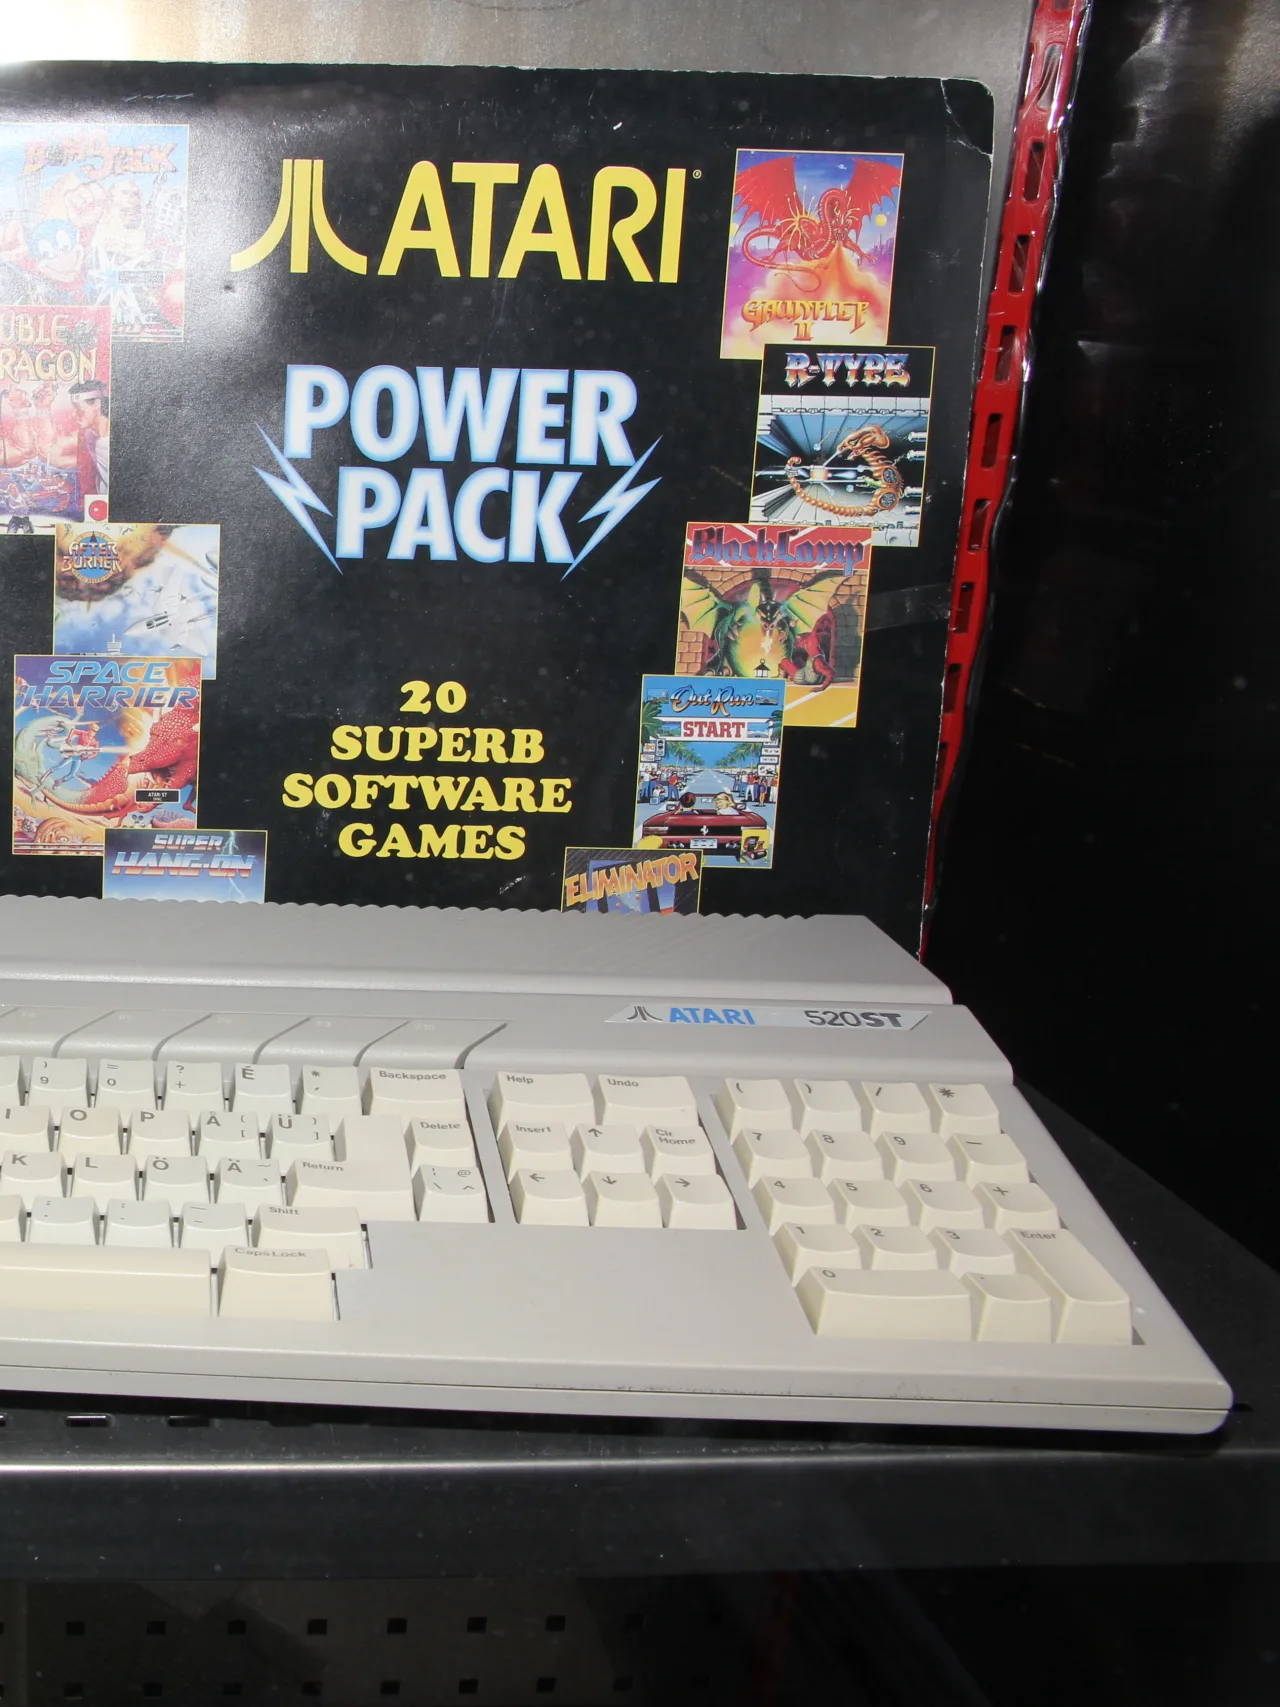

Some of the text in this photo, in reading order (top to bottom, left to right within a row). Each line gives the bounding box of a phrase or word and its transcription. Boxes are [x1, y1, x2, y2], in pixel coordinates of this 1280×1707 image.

[741, 300, 870, 334] GAUNTLET
[793, 322, 813, 341] II
[785, 353, 910, 388] R-TYPE
[283, 364, 638, 466] POWER
[335, 466, 583, 564] PACK
[69, 542, 118, 556] AFTER
[61, 556, 122, 572] BURNER
[45, 661, 172, 683] SPACE
[21, 686, 198, 708] HARRIER
[400, 680, 466, 713] 20
[683, 721, 745, 737] START
[331, 725, 544, 764] SUPERB
[282, 773, 572, 813] SOFTWARE
[152, 834, 223, 850] SUPER
[338, 823, 526, 860] GAMES
[565, 851, 699, 907] ELIMINATOR
[670, 1007, 755, 1025] ATARI
[804, 1011, 902, 1028] 520ST
[379, 1071, 446, 1081] Backspace
[507, 1075, 533, 1084] Help
[607, 1079, 638, 1087] Undo
[141, 1111, 155, 1122] P
[207, 1111, 221, 1126] Å
[278, 1114, 292, 1129] Ü
[516, 1125, 551, 1133] Insert
[752, 1132, 762, 1141] 7
[12, 1154, 27, 1165] K
[85, 1157, 98, 1168] L
[153, 1157, 169, 1170] Ö
[227, 1159, 242, 1173] Ä
[302, 1161, 343, 1171] Return
[269, 1205, 298, 1215] Shift
[1020, 1231, 1056, 1239] Enter
